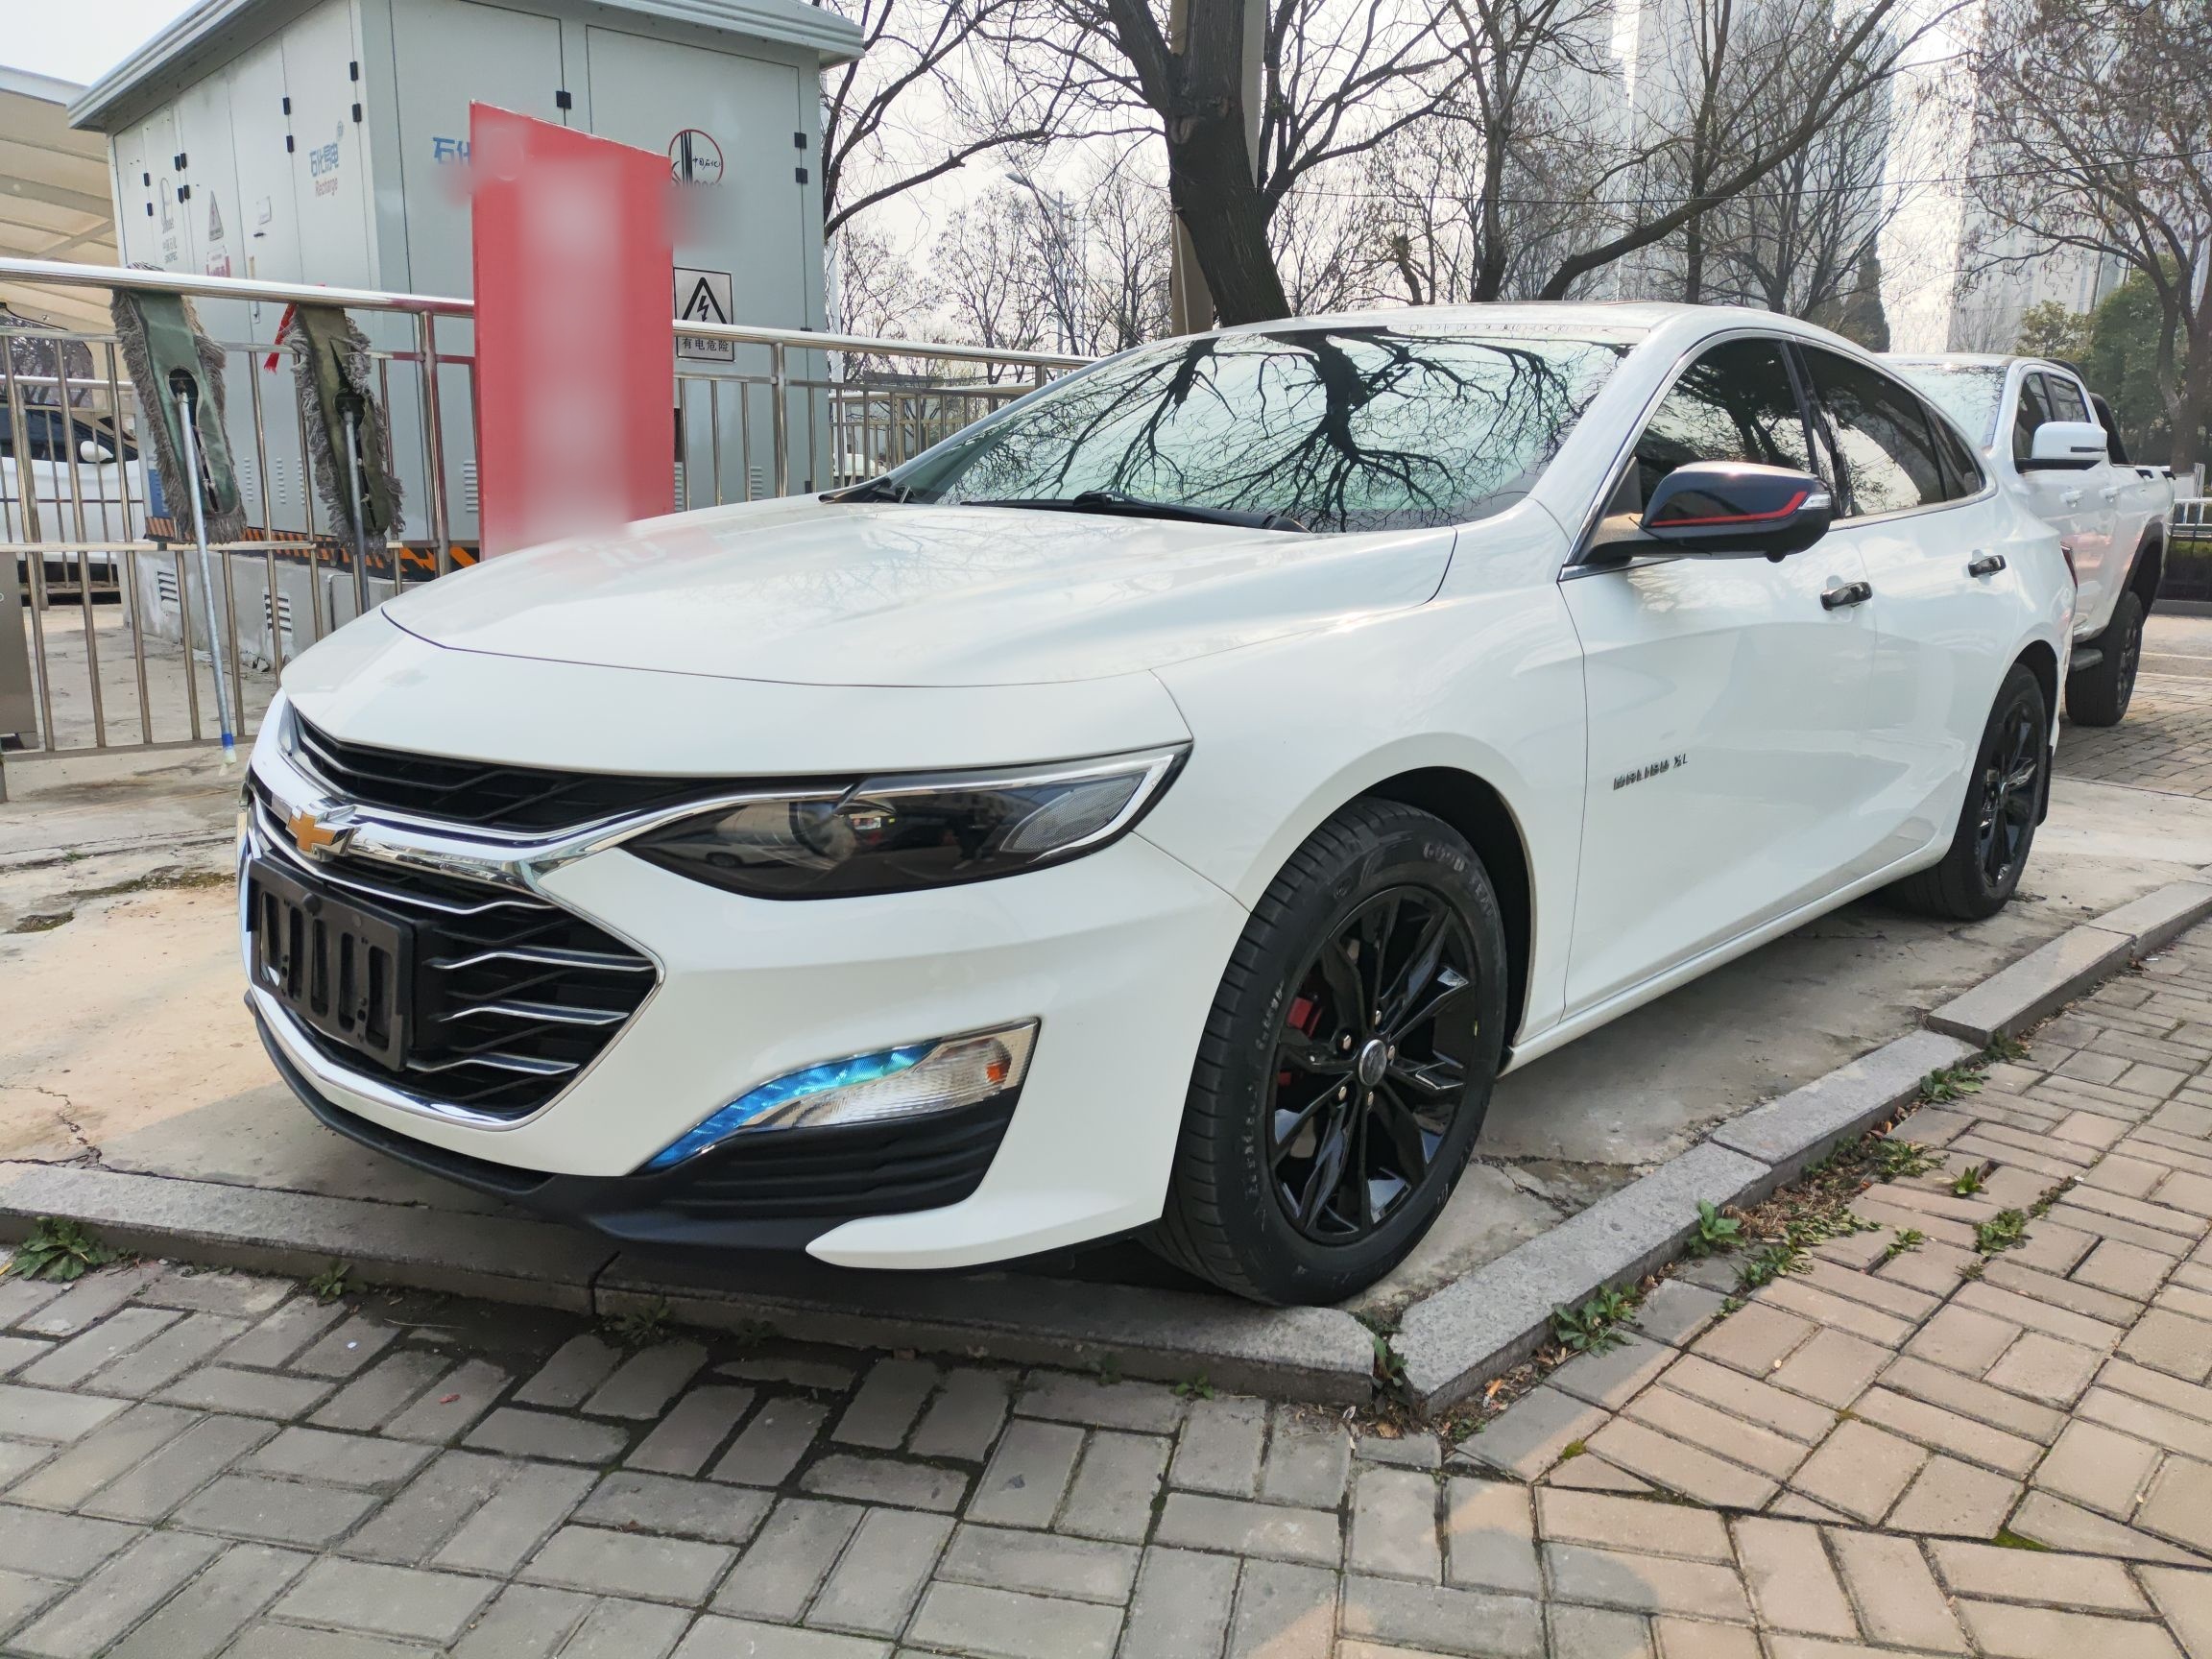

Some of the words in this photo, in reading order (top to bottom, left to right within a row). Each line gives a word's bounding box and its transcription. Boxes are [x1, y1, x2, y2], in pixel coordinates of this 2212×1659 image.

[682, 337, 730, 352] 有电危险
[1673, 753, 1689, 769] XL
